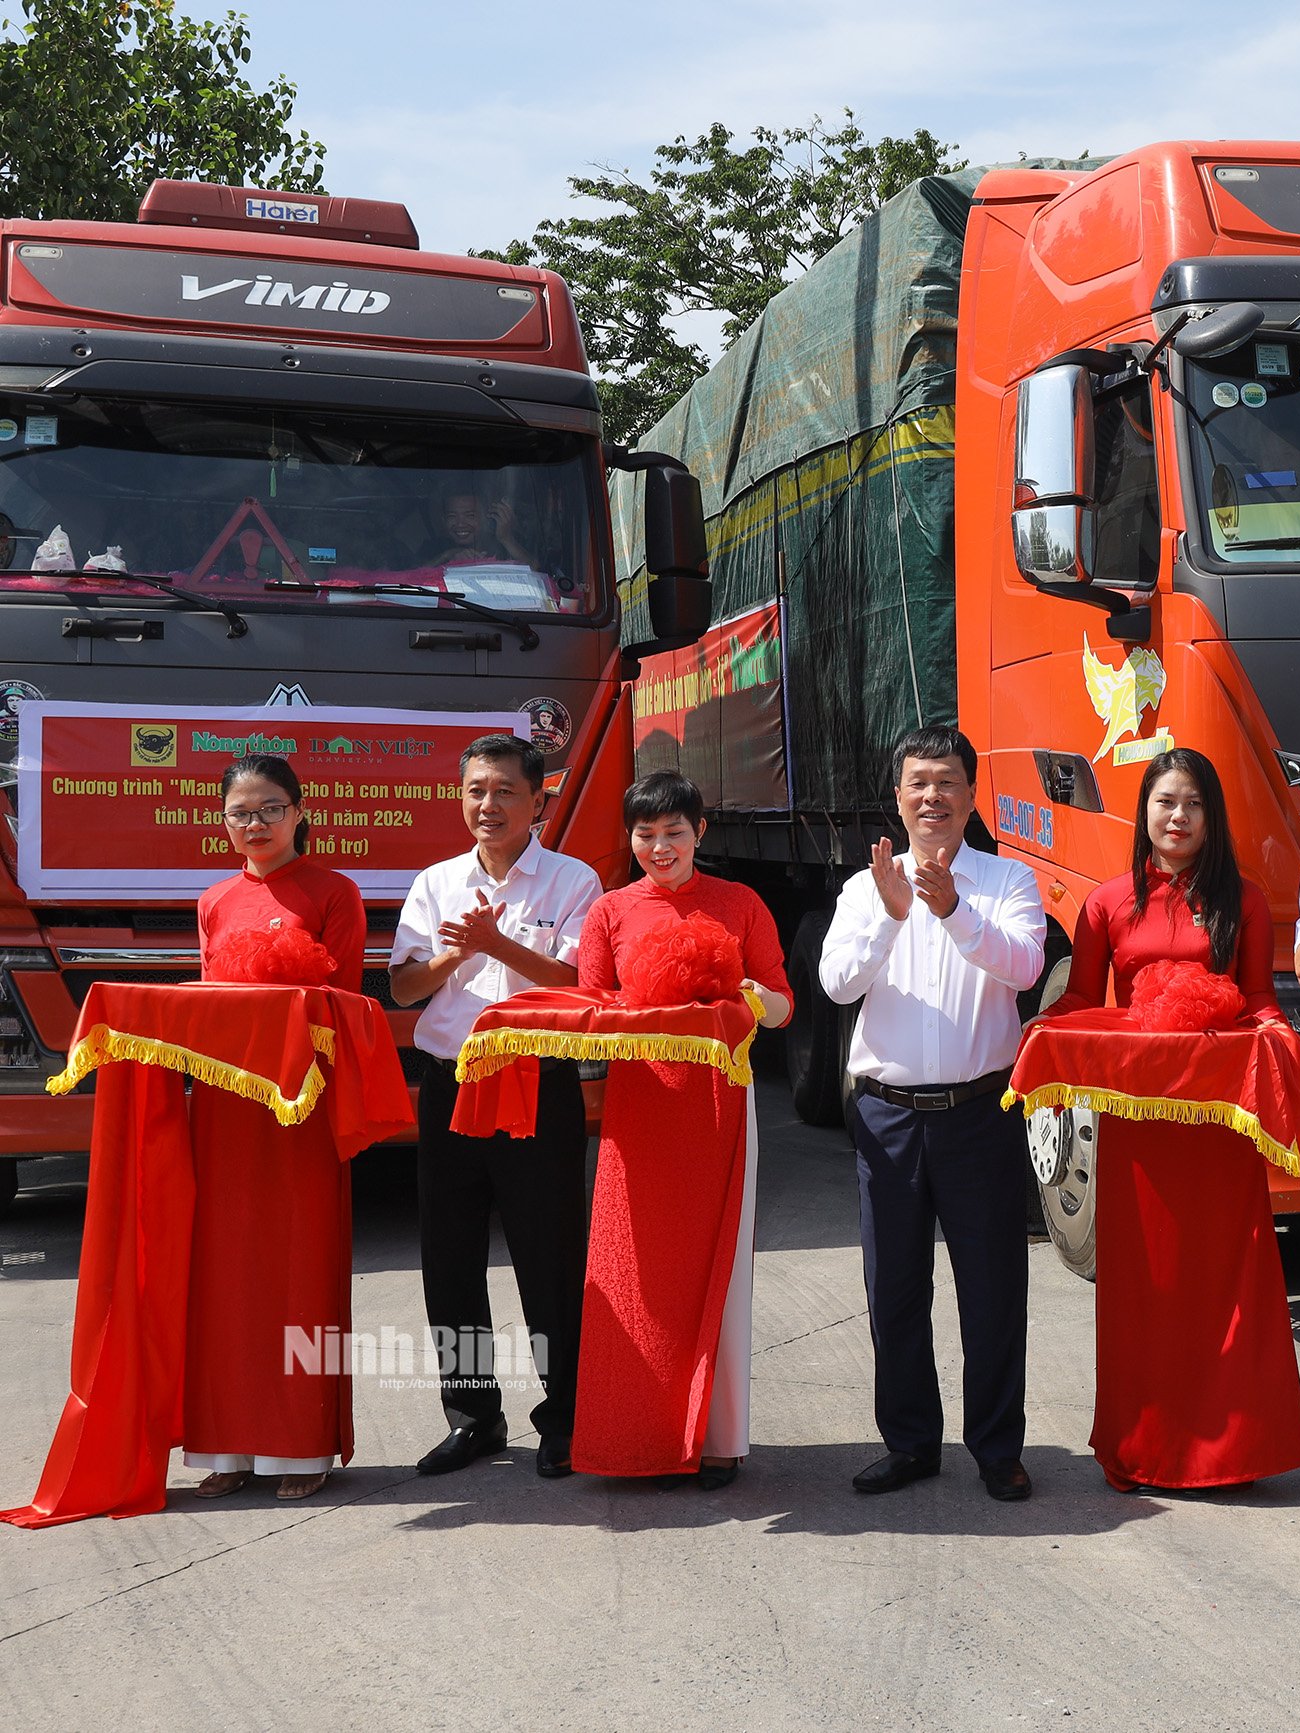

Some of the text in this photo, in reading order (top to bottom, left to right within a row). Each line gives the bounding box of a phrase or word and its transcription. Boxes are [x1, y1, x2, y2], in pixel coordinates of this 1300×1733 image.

[247, 200, 317, 222] Haier
[52, 778, 117, 797] Chương
[123, 778, 163, 796] trình
[301, 781, 329, 798] cho
[334, 781, 354, 798] bà
[359, 783, 389, 799] con
[394, 783, 432, 801] vùng
[154, 805, 188, 825] tỉnh
[193, 807, 223, 825] Lào
[334, 809, 369, 826] năm
[373, 810, 413, 826] 2024
[202, 837, 229, 855] (Xe
[316, 835, 336, 854] hỗ
[341, 838, 369, 858] trợ)
